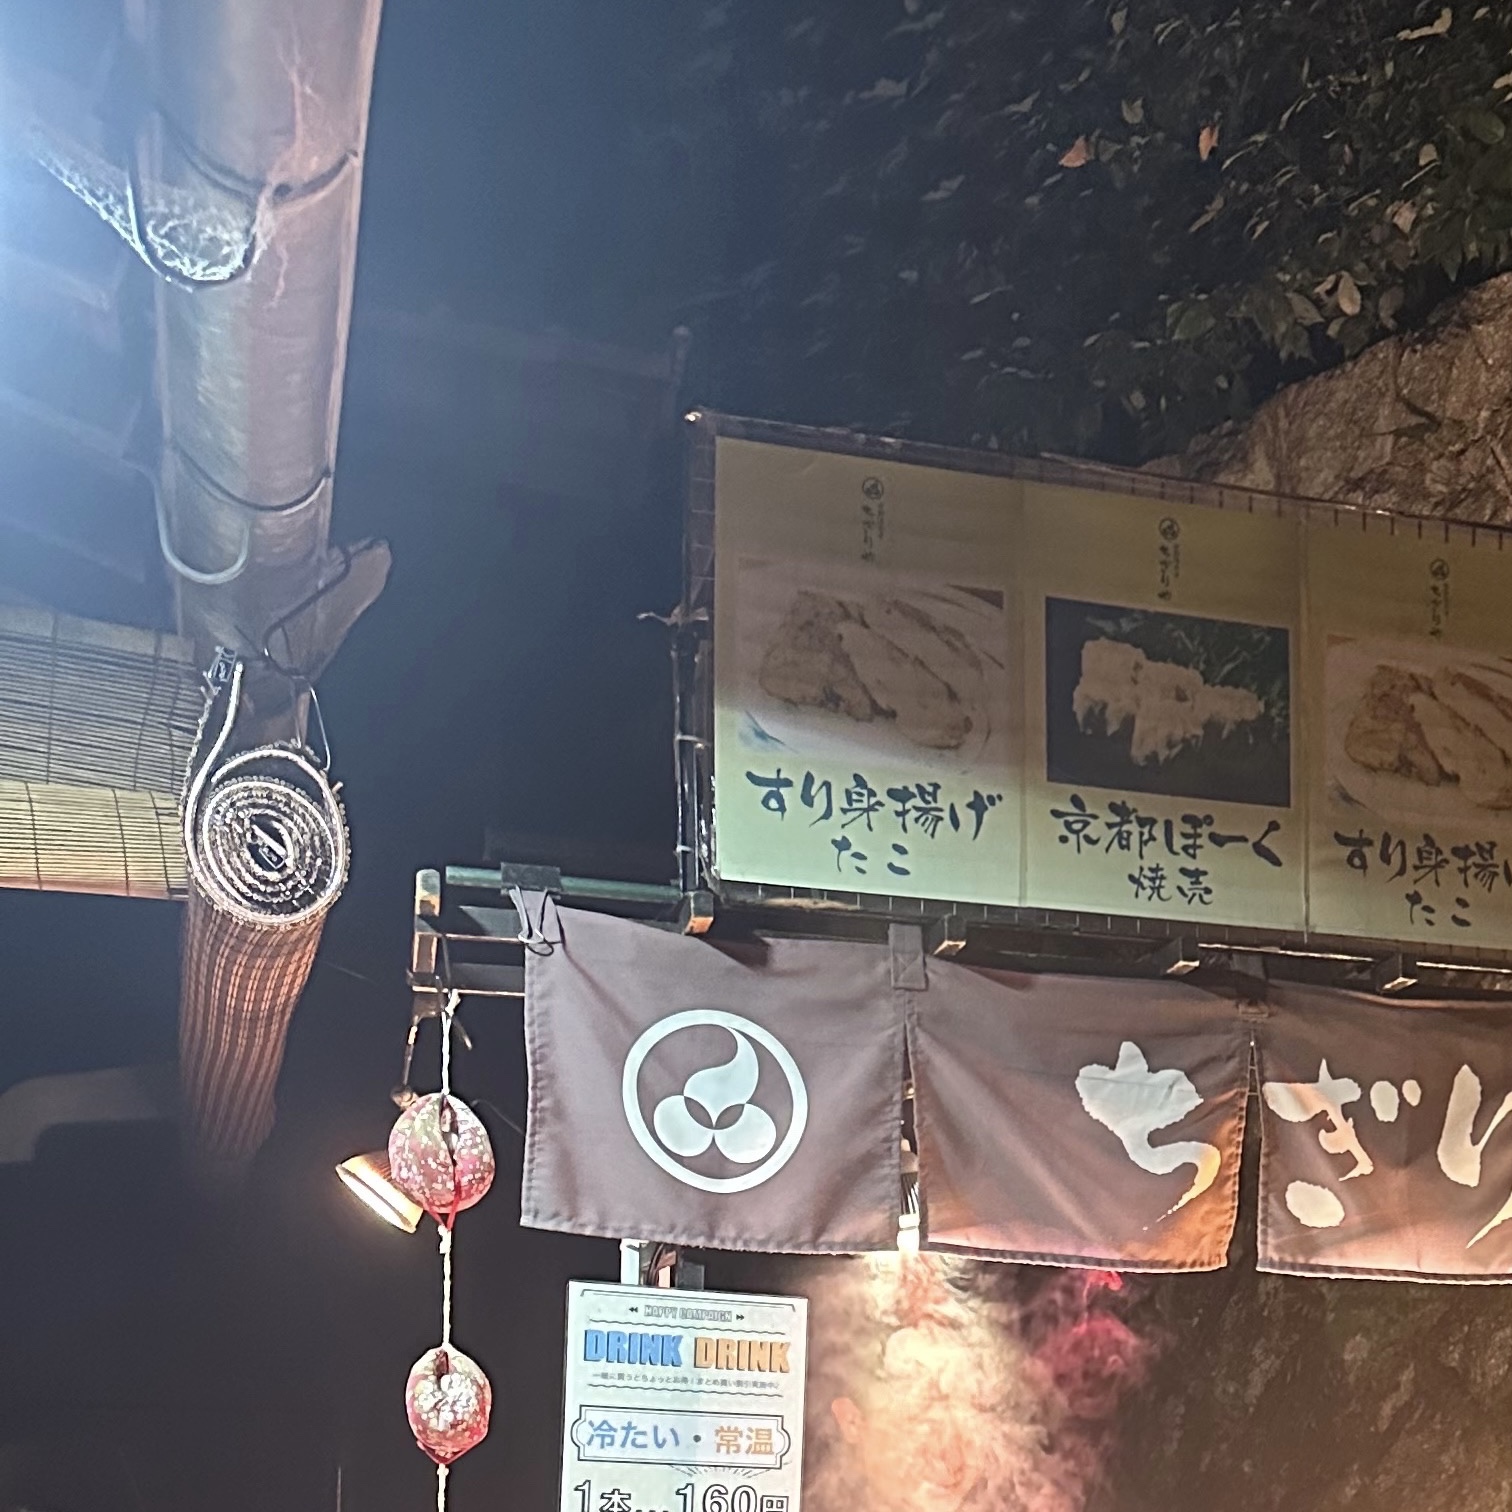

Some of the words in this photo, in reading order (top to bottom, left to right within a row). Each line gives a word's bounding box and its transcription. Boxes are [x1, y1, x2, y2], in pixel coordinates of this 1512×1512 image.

[745, 768, 1002, 841] すり身揚げ
[1050, 795, 1283, 868] 京都ぽーく
[831, 835, 911, 876] たこ
[1128, 866, 1215, 906] 焼売
[1406, 890, 1473, 928] たこ
[644, 1305, 677, 1319] HAPPY
[679, 1308, 732, 1322] CAMPAIGN
[584, 1329, 684, 1367] DRINK
[694, 1337, 791, 1373] DRINK
[586, 1420, 775, 1456] 冷たい・常温
